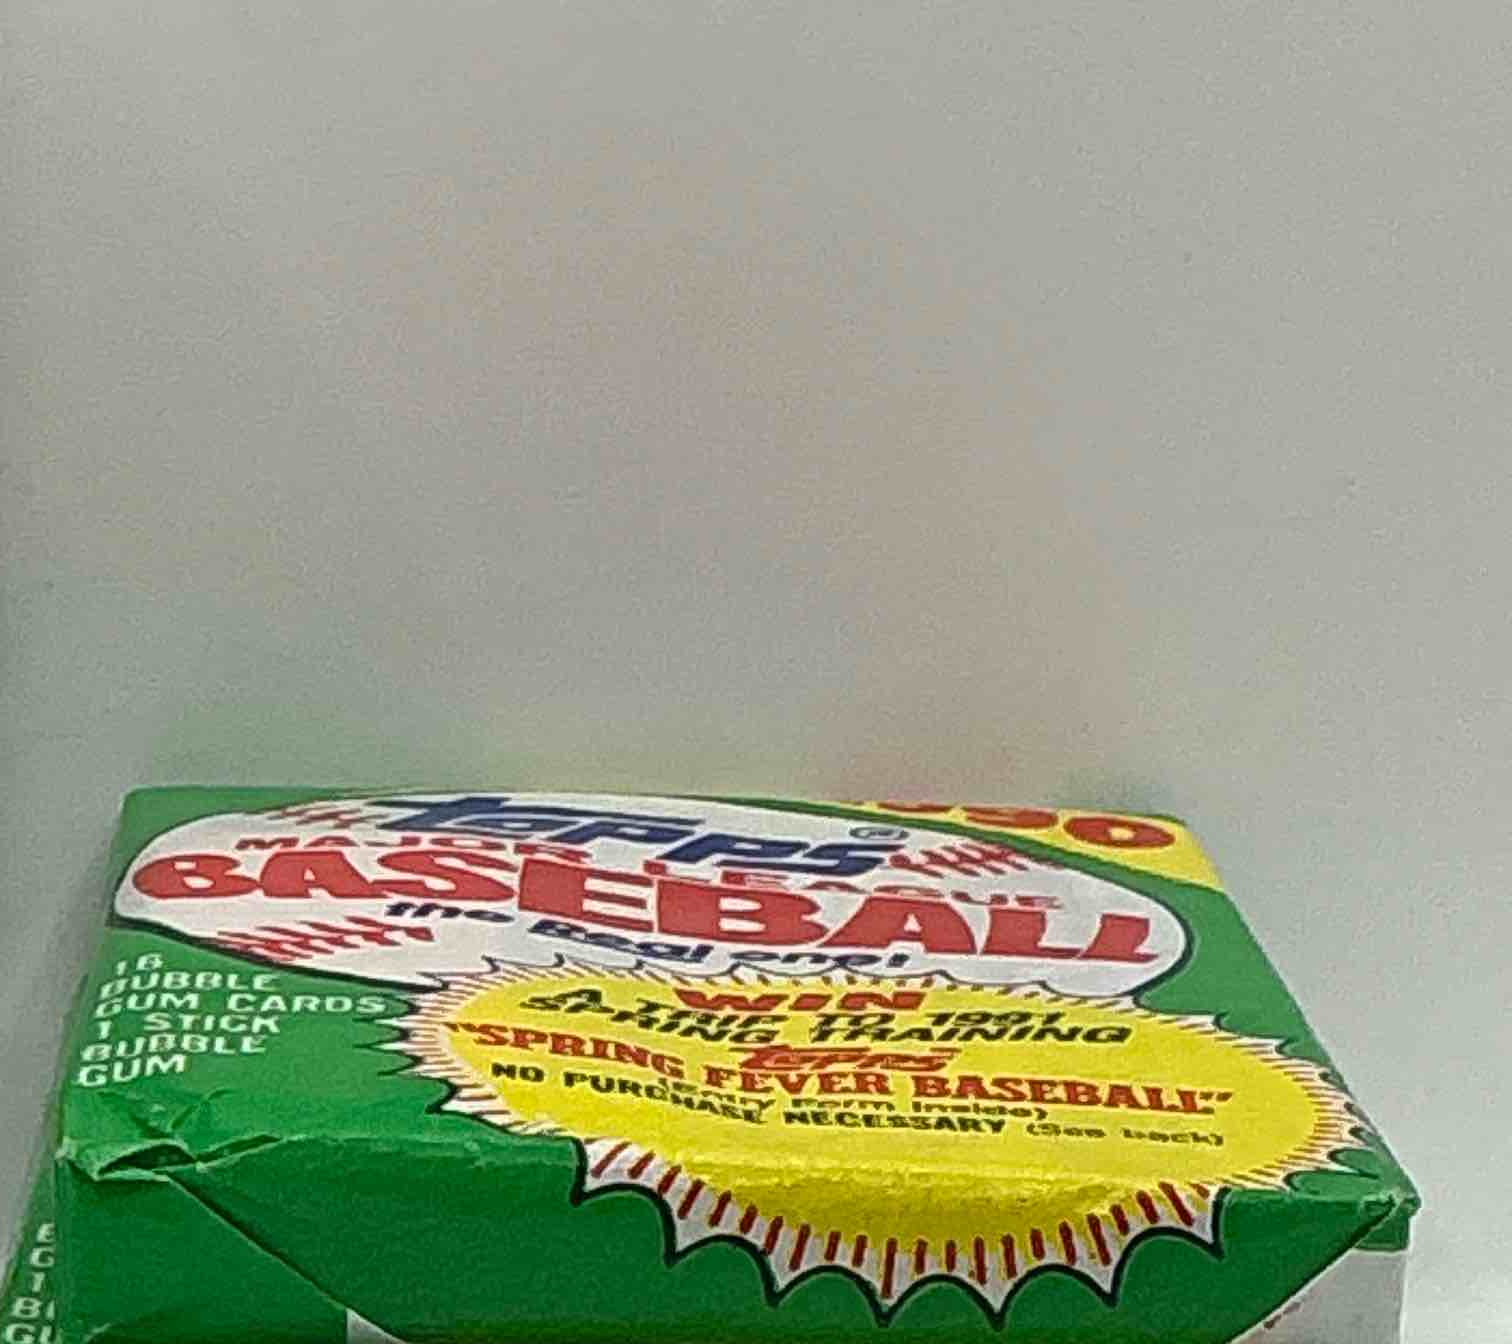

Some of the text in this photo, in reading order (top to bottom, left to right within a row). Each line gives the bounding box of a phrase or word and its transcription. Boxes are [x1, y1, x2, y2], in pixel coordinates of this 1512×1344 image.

[236, 836, 1063, 910] MAJOR LEAGUE
[132, 850, 1158, 963] BASEBALL
[384, 902, 514, 923] the
[528, 919, 714, 963] Real
[99, 971, 281, 1000] BUBBLE
[674, 988, 928, 1011] WIN
[95, 992, 386, 1019] GUM CARDS
[143, 1012, 281, 1034] STICK
[810, 1026, 1131, 1043] TRAINING
[80, 1033, 269, 1062] BUBBLE
[76, 1054, 186, 1088] GUM
[443, 1022, 1233, 1113] "SPRING FEVER BASEBALL"
[491, 1062, 545, 1082] NO
[564, 1071, 768, 1124] PURCHASE
[783, 1111, 1006, 1134] NECESSARY
